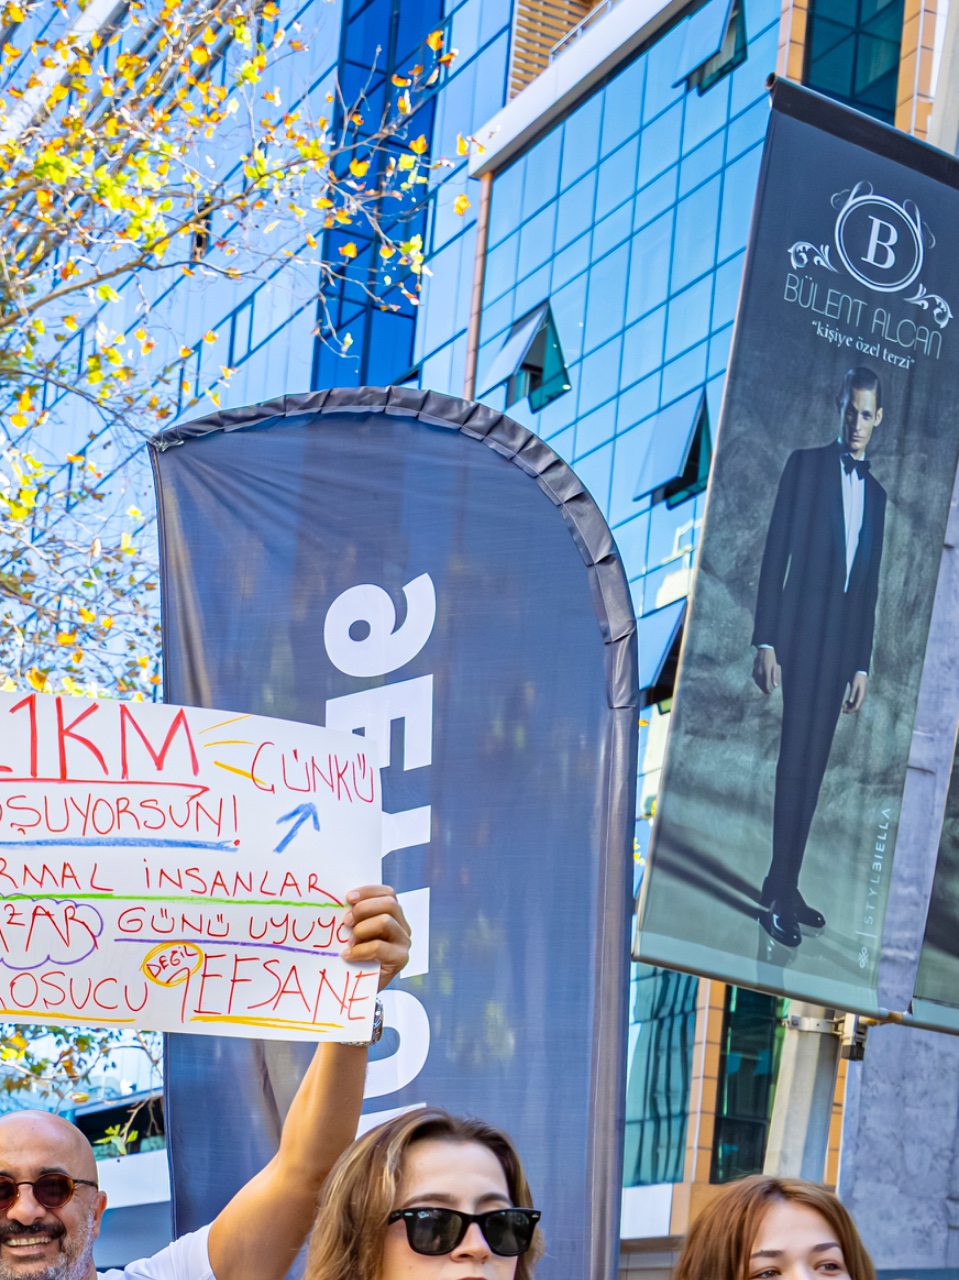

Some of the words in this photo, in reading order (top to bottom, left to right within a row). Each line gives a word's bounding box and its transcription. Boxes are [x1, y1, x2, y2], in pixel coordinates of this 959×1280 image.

[861, 215, 898, 269] B
[783, 272, 868, 327] BÜLENT
[855, 336, 881, 358] özel
[118, 906, 230, 938] GÜNÜ
